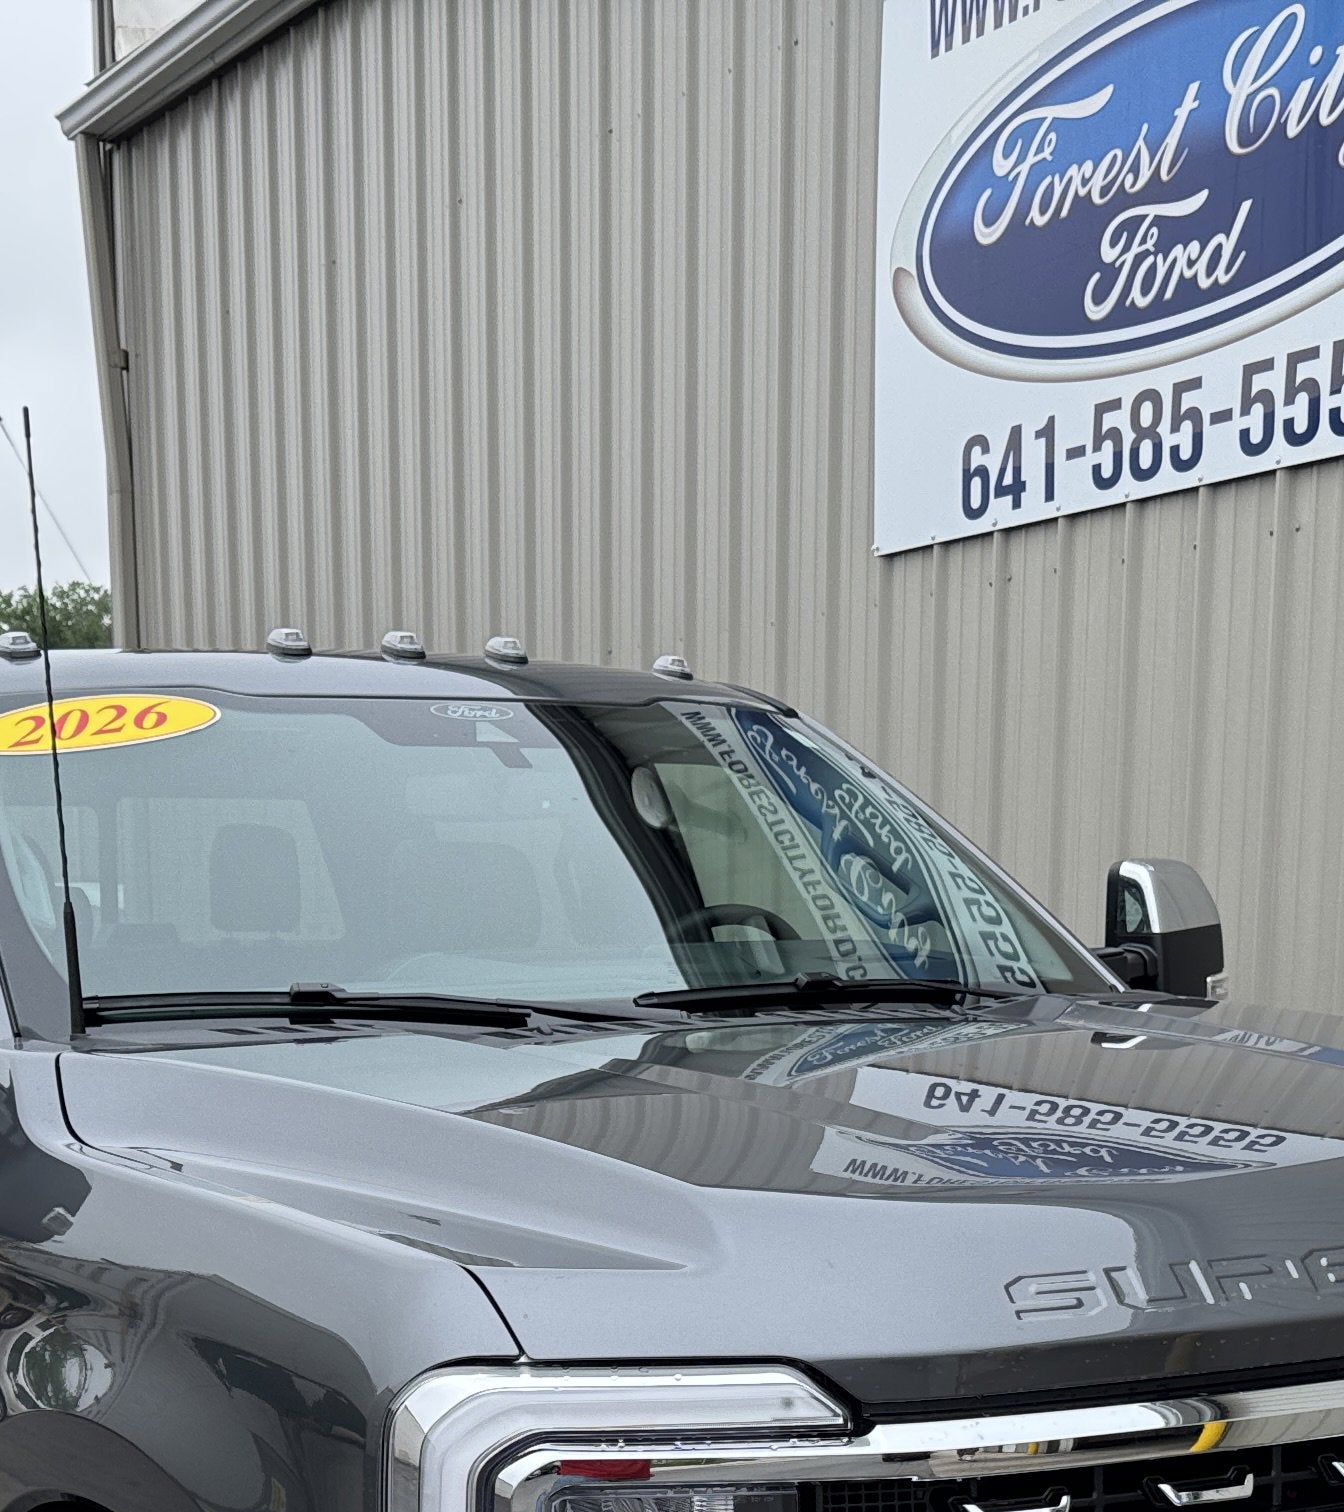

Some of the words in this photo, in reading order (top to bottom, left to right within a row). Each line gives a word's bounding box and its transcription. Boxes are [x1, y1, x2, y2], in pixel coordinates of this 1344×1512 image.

[973, 80, 1201, 247] Forest
[1083, 189, 1253, 322] Ford
[7, 701, 168, 749] 2026
